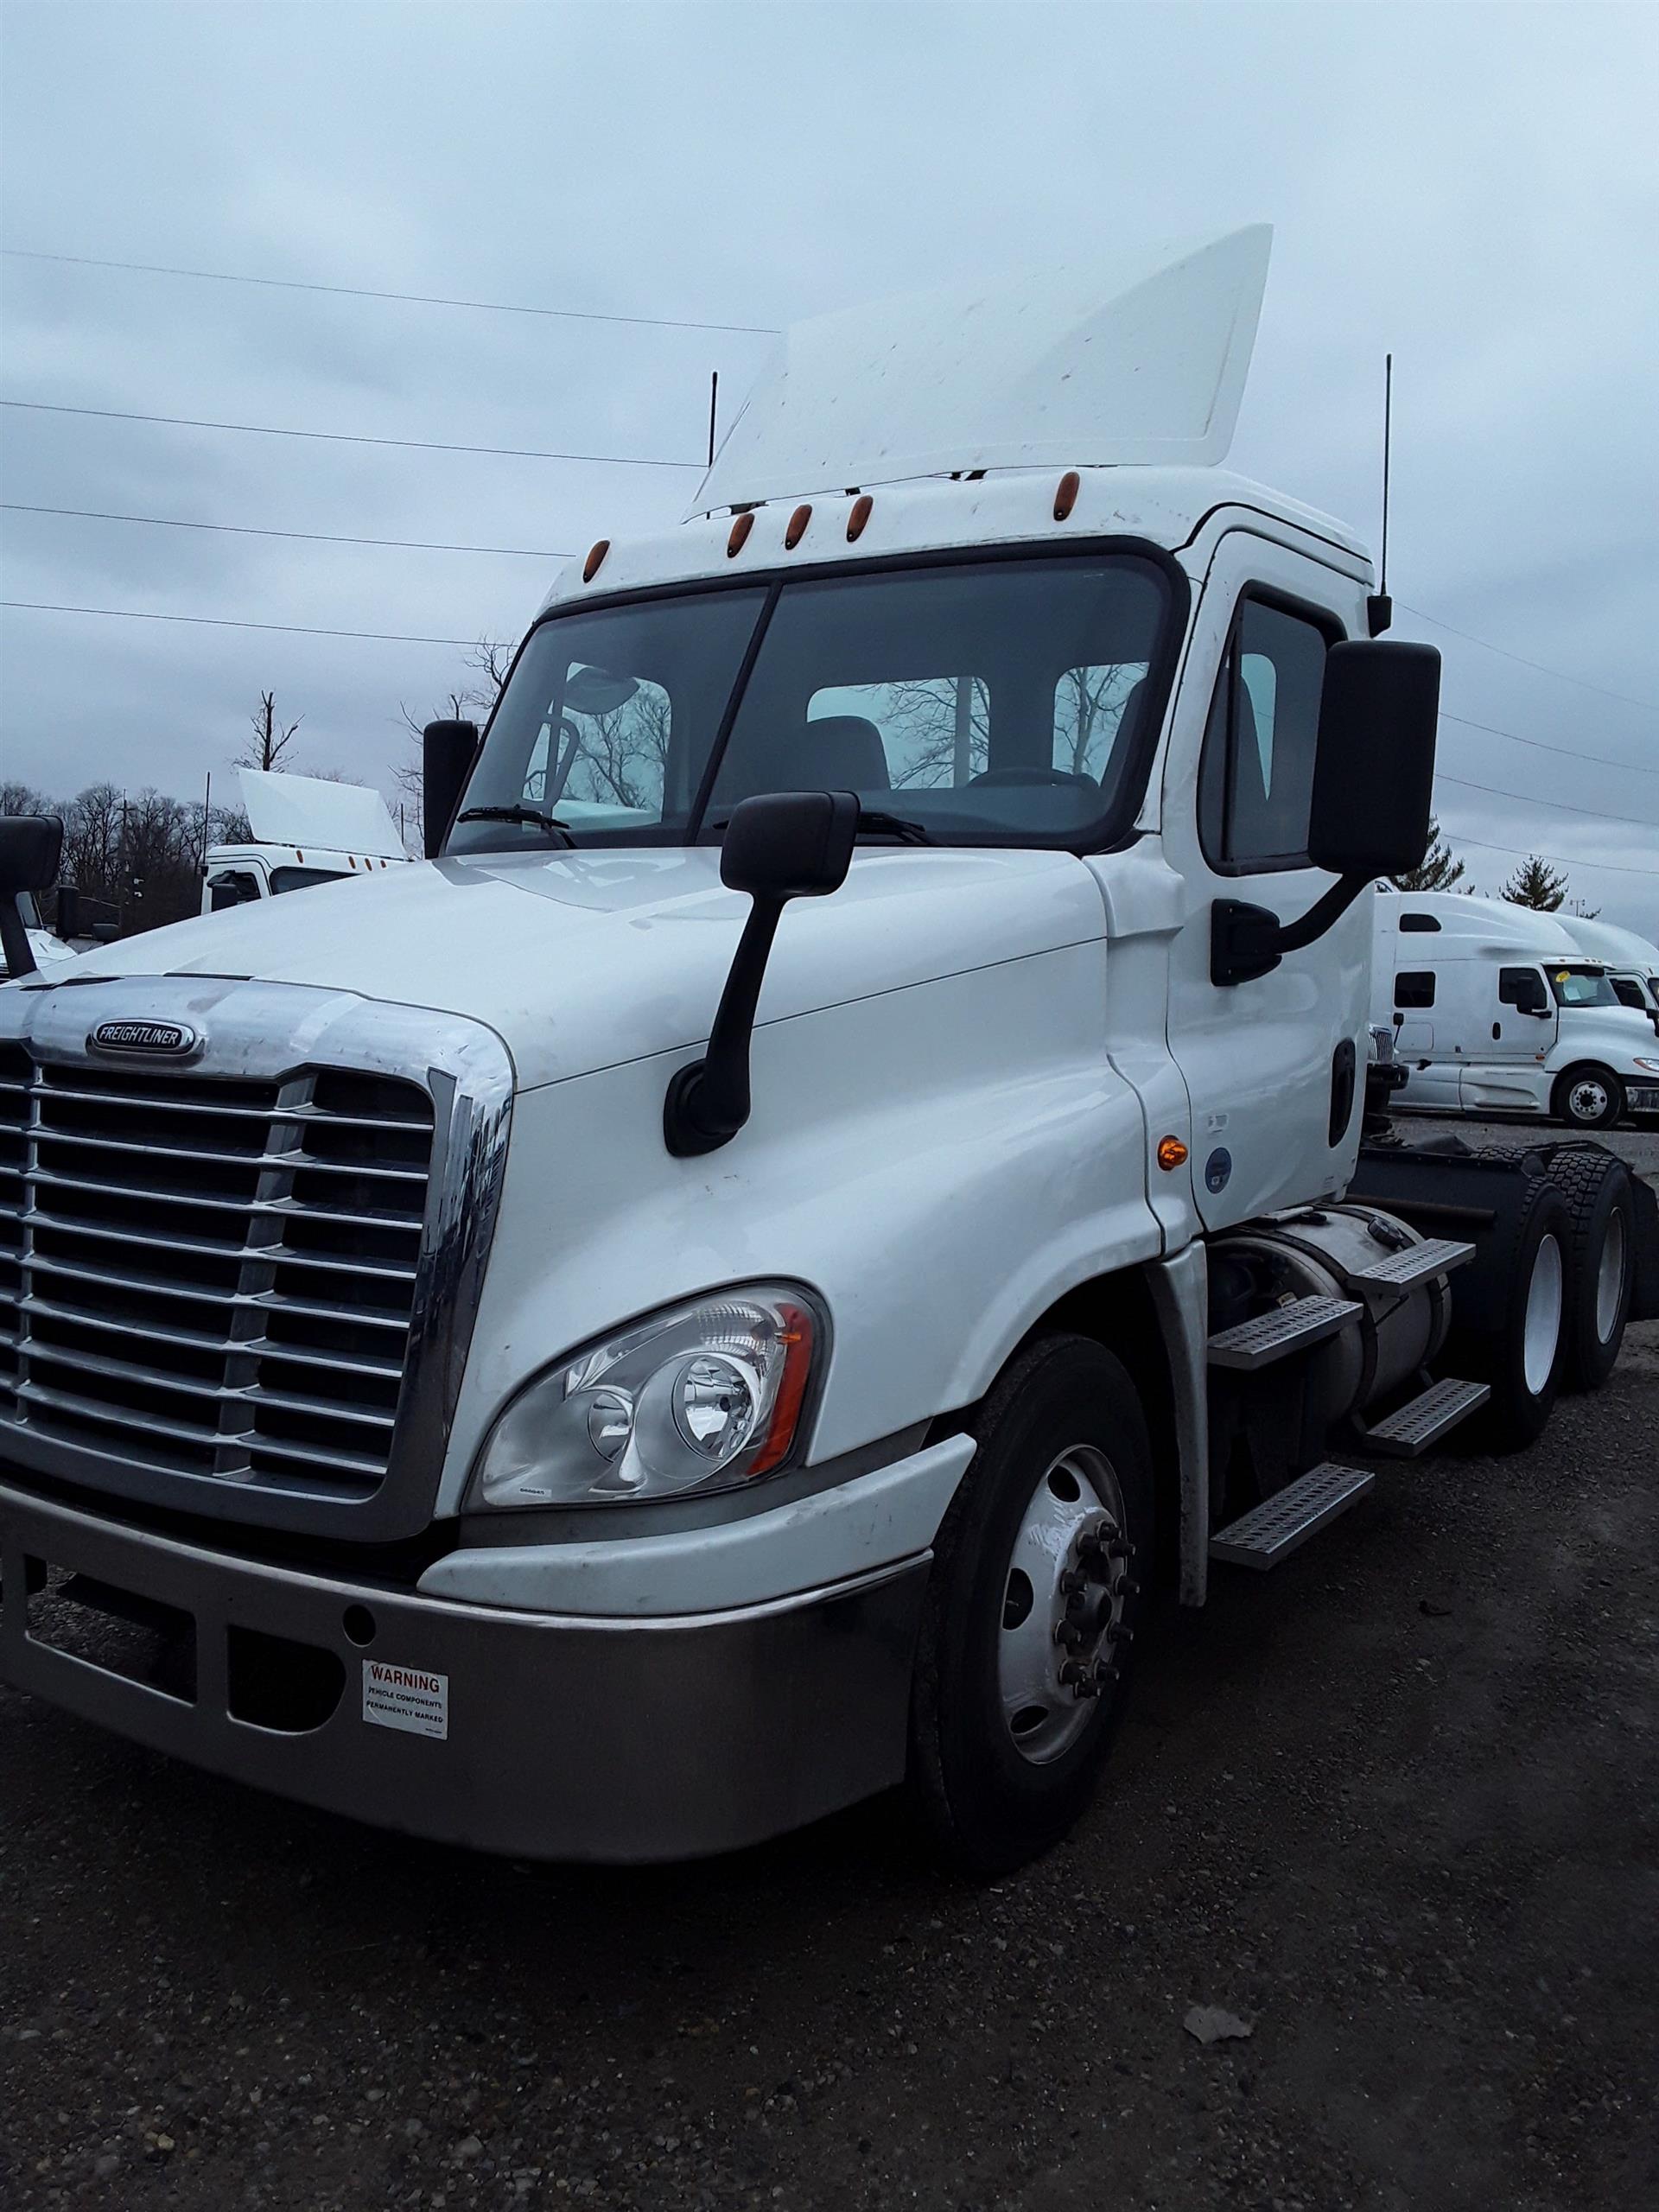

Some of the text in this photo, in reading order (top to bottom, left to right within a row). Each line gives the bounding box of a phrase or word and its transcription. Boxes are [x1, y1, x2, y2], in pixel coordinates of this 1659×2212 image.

[99, 1027, 179, 1045] FREIGHTLINER
[371, 1665, 440, 1693] WARNING
[368, 1686, 442, 1709] VEHICLE COMPONENTS
[366, 1700, 443, 1723] PERMANENTLY MARKED
